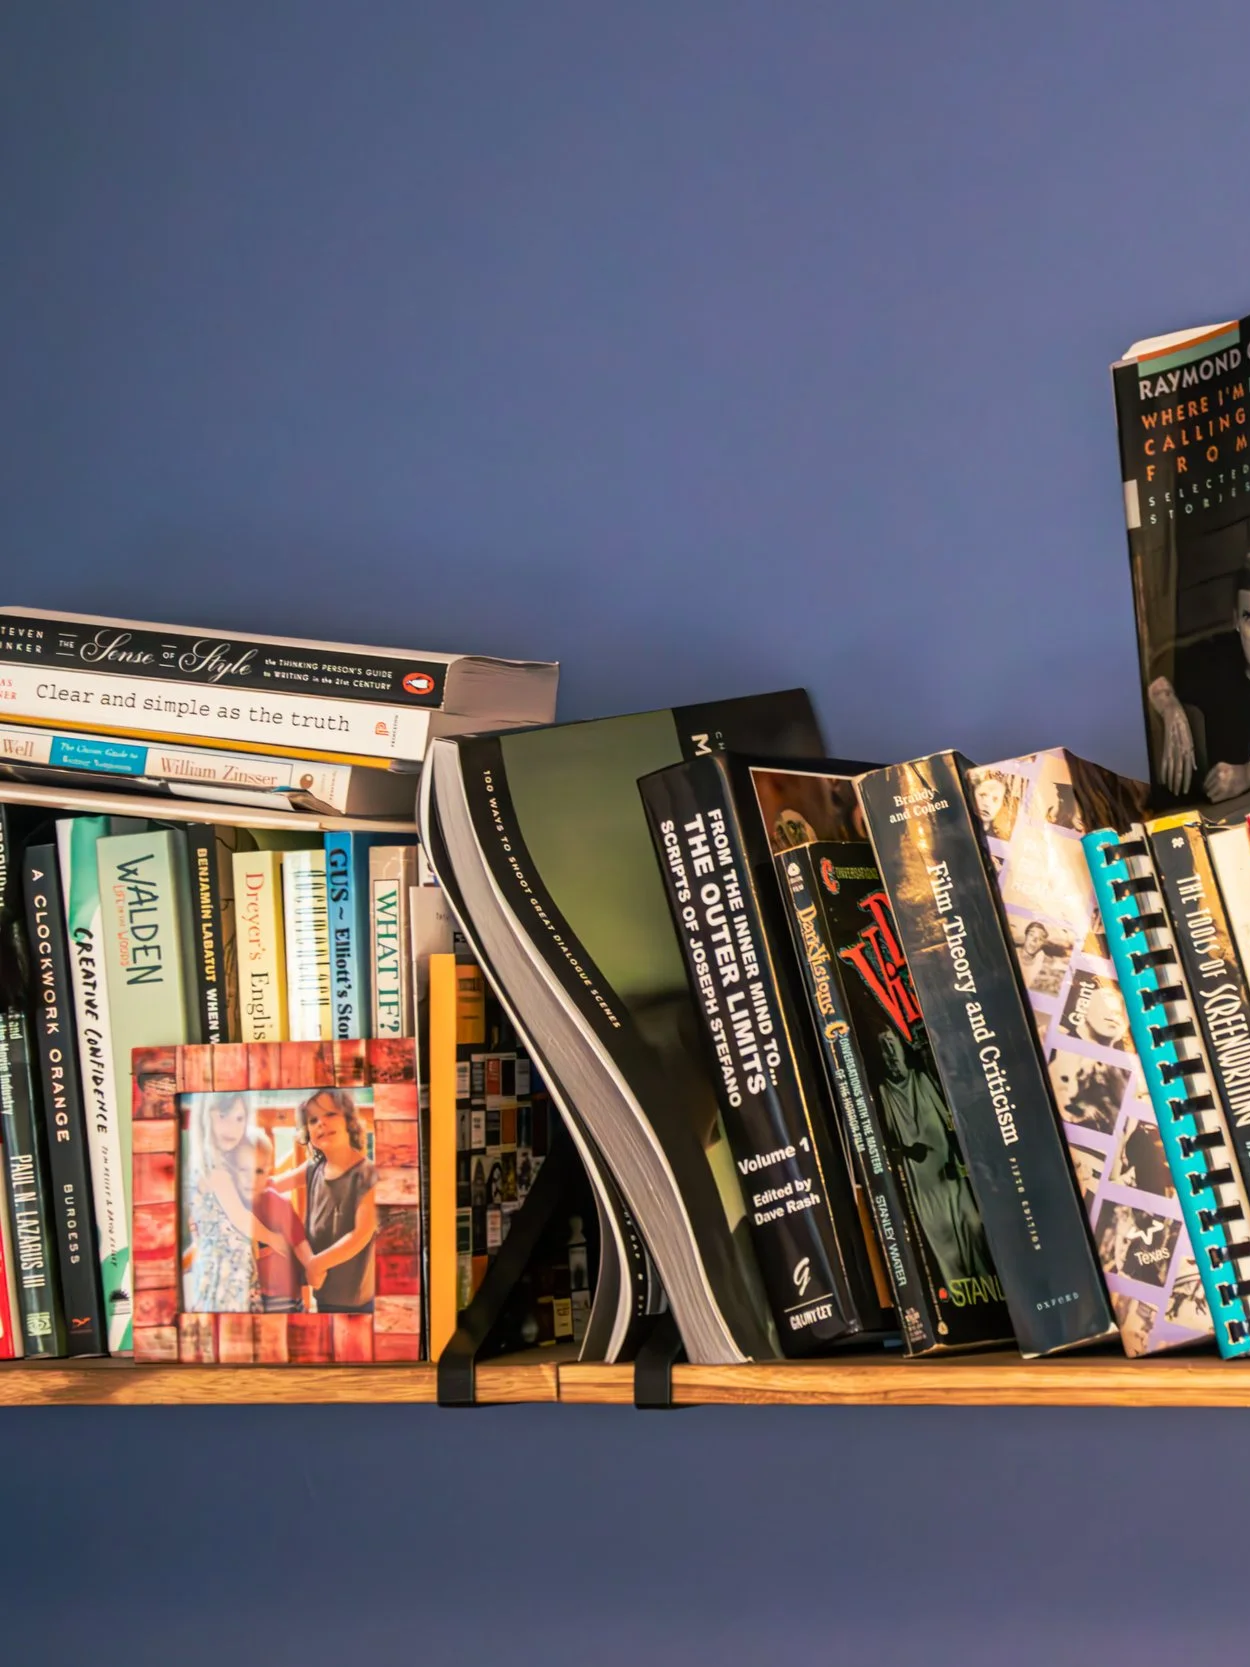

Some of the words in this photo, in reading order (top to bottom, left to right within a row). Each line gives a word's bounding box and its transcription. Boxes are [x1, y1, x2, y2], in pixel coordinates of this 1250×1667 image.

[1138, 349, 1241, 400] RAYMOND
[1141, 398, 1208, 431] WHERE
[1218, 382, 1245, 407] I'M
[1144, 408, 1246, 456] CALLING
[1146, 438, 1247, 482] FROM
[1149, 464, 1249, 507] SELECTED
[1150, 481, 1250, 525] STORIES
[0, 626, 44, 639] TEVEN
[0, 641, 42, 654] INKER
[59, 639, 74, 649] THE
[80, 629, 156, 665] Sense
[162, 652, 175, 660] OF
[179, 640, 259, 682] Style
[265, 658, 276, 667] the
[279, 659, 319, 671] THINKING
[322, 663, 363, 676] PERSON'S
[366, 668, 393, 679] GUIDE
[274, 670, 309, 682] WRITING
[353, 680, 392, 691] CENTURY
[36, 684, 94, 704] Clear
[100, 692, 136, 709] and
[143, 695, 210, 718] simple
[216, 706, 240, 719] as
[249, 706, 283, 725] the
[291, 711, 350, 733] truth
[3, 738, 34, 758] Well
[161, 757, 216, 779] William
[222, 765, 277, 787] Zinsser
[889, 810, 912, 824] and
[912, 797, 950, 818] Cohen
[31, 869, 45, 882] A
[197, 848, 213, 919] BENJAMÍN
[329, 848, 349, 903] GUS
[661, 820, 691, 903] SCRIPTS
[482, 769, 493, 793] 100
[489, 797, 505, 831] WAYS
[500, 836, 512, 854] TO
[508, 856, 529, 895] SHOOT
[530, 897, 555, 932] GREAT
[552, 933, 592, 988] DIALOGUE
[590, 988, 622, 1029] SCENES
[926, 860, 954, 914] Film
[1176, 873, 1206, 904] THE
[116, 853, 164, 986] WALDEN
[241, 872, 265, 961] Dreyer's
[376, 889, 399, 980] WHAT
[682, 906, 700, 933] OF
[1185, 907, 1221, 955] TOOLS
[34, 895, 60, 1034] CLOCKWORK
[201, 922, 217, 983] LABATUT
[334, 927, 353, 999] Elliott's
[684, 813, 715, 878] THE
[700, 882, 741, 988] OUTER
[726, 991, 766, 1096] LIMITS
[707, 809, 732, 866] FROM
[722, 868, 744, 912] THE
[733, 915, 760, 980] INNER
[749, 981, 773, 1036] MIND
[763, 1038, 781, 1087] TO...
[944, 915, 977, 994] Theory
[1198, 958, 1228, 979] OF
[73, 927, 100, 1021] CREATIVE
[690, 938, 719, 1015] JOSEPH
[206, 987, 220, 1031] WHEN
[247, 971, 271, 1041] Englis
[380, 989, 401, 1033] IF?
[966, 1000, 995, 1044] and
[1068, 980, 1097, 1026] Grant
[84, 1028, 108, 1134] CONFIDENCE
[710, 1017, 742, 1108] STEFANO
[1, 1073, 15, 1115] Industry
[49, 1048, 70, 1143] ORANGE
[855, 1097, 869, 1118] WITH
[979, 1045, 1019, 1146] Criticism
[852, 1130, 866, 1152] FILM
[862, 1119, 873, 1136] THE
[10, 1154, 34, 1188] PAUL
[737, 1143, 797, 1177] Volume
[799, 1137, 811, 1153] 1
[866, 1136, 883, 1175] MASTERS
[752, 1185, 794, 1209] Edited
[795, 1178, 814, 1197] by
[753, 1203, 786, 1228] Dave
[786, 1194, 820, 1216] Rash
[1008, 1157, 1025, 1194] FIFTH
[1021, 1200, 1042, 1251] EDITION
[16, 1210, 45, 1276] LAZARUS
[63, 1184, 80, 1265] BURGESS
[875, 1194, 896, 1241] STANLEY
[888, 1243, 907, 1287] WIATER
[1134, 1247, 1170, 1266] Texas
[23, 1276, 46, 1288] III
[1036, 1291, 1080, 1312] OXFORD
[788, 1304, 834, 1331] GAUNTLET
